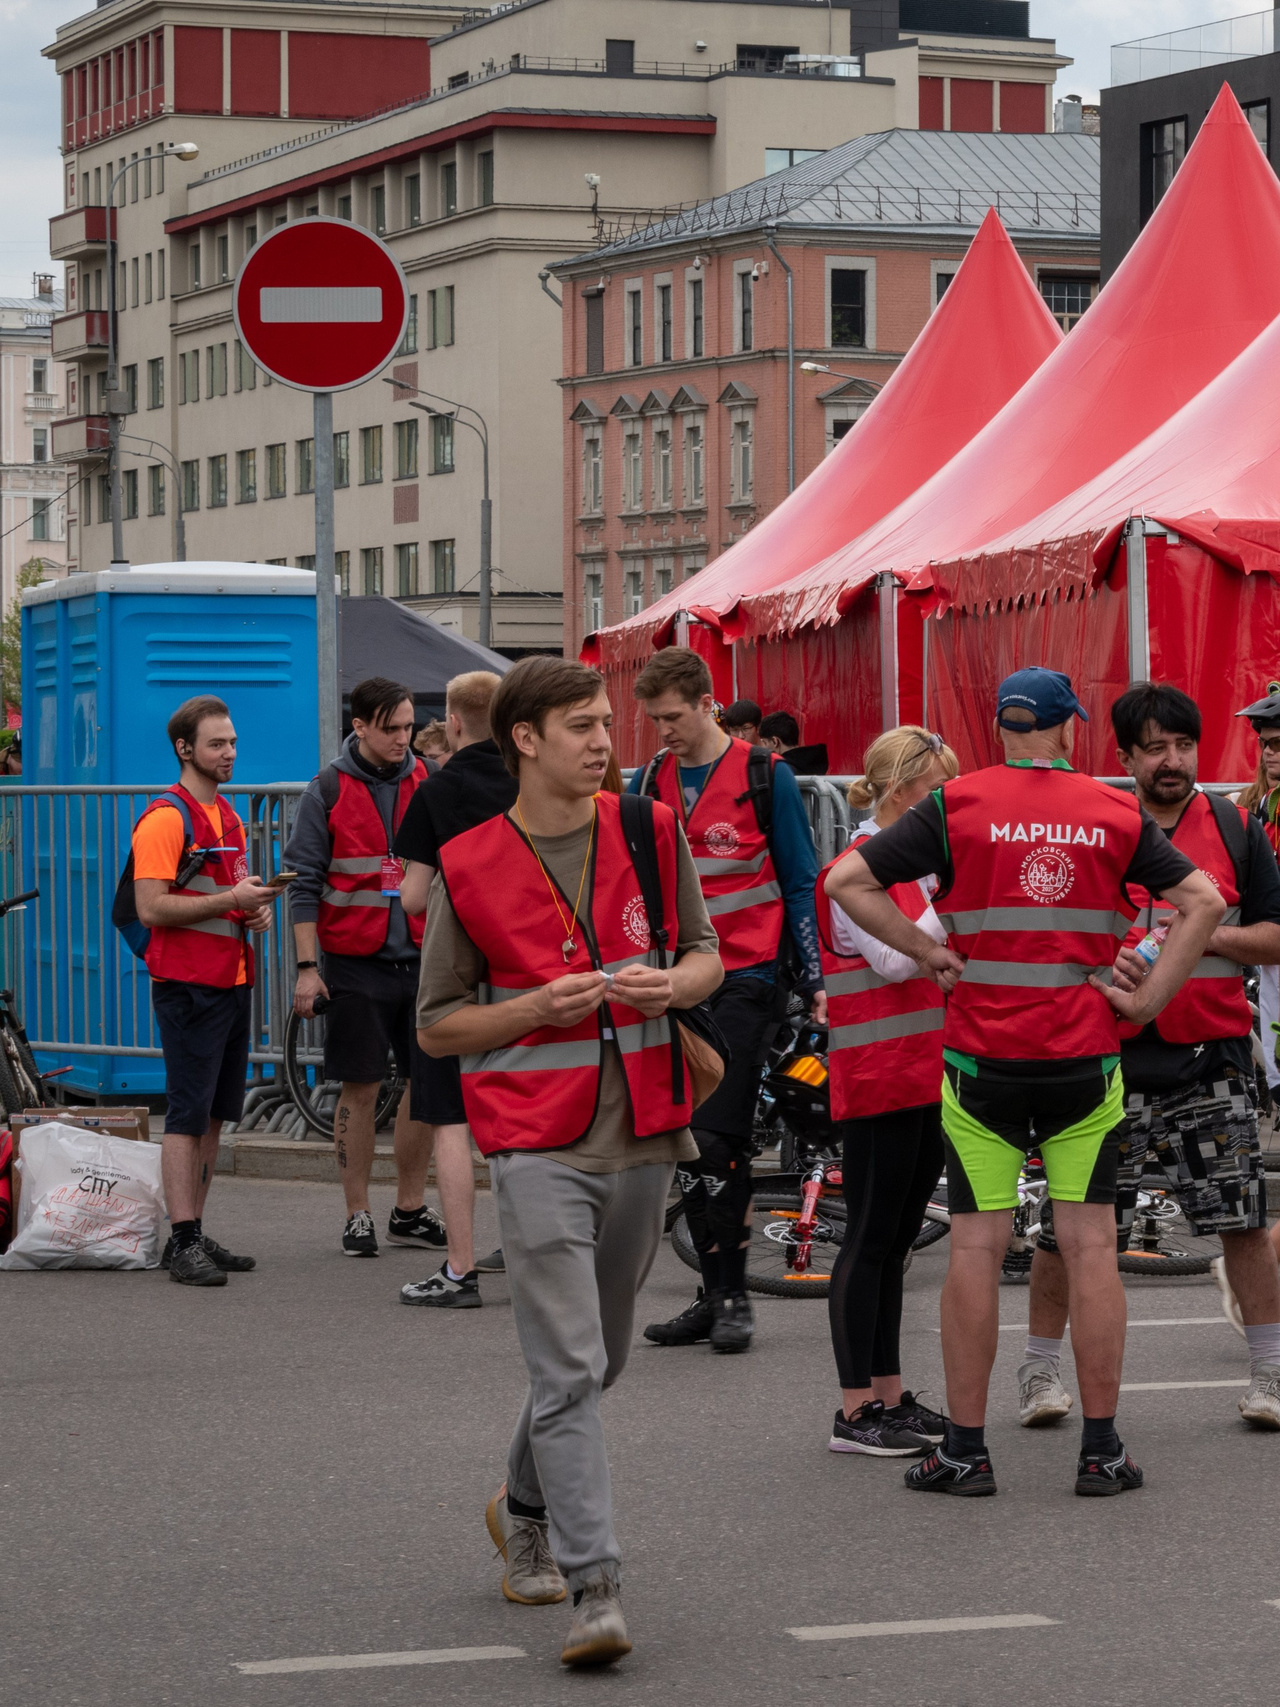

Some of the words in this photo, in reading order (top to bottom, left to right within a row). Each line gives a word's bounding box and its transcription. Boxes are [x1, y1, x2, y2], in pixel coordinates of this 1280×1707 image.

[990, 822, 1105, 848] МАРШАЛ
[1021, 846, 1075, 870] МОСКОВСКИЙ
[1019, 875, 1075, 903] ВЕЛОФЕСТИВАЛЬ
[79, 1175, 118, 1197] CITY
[92, 1169, 131, 1181] gentleman
